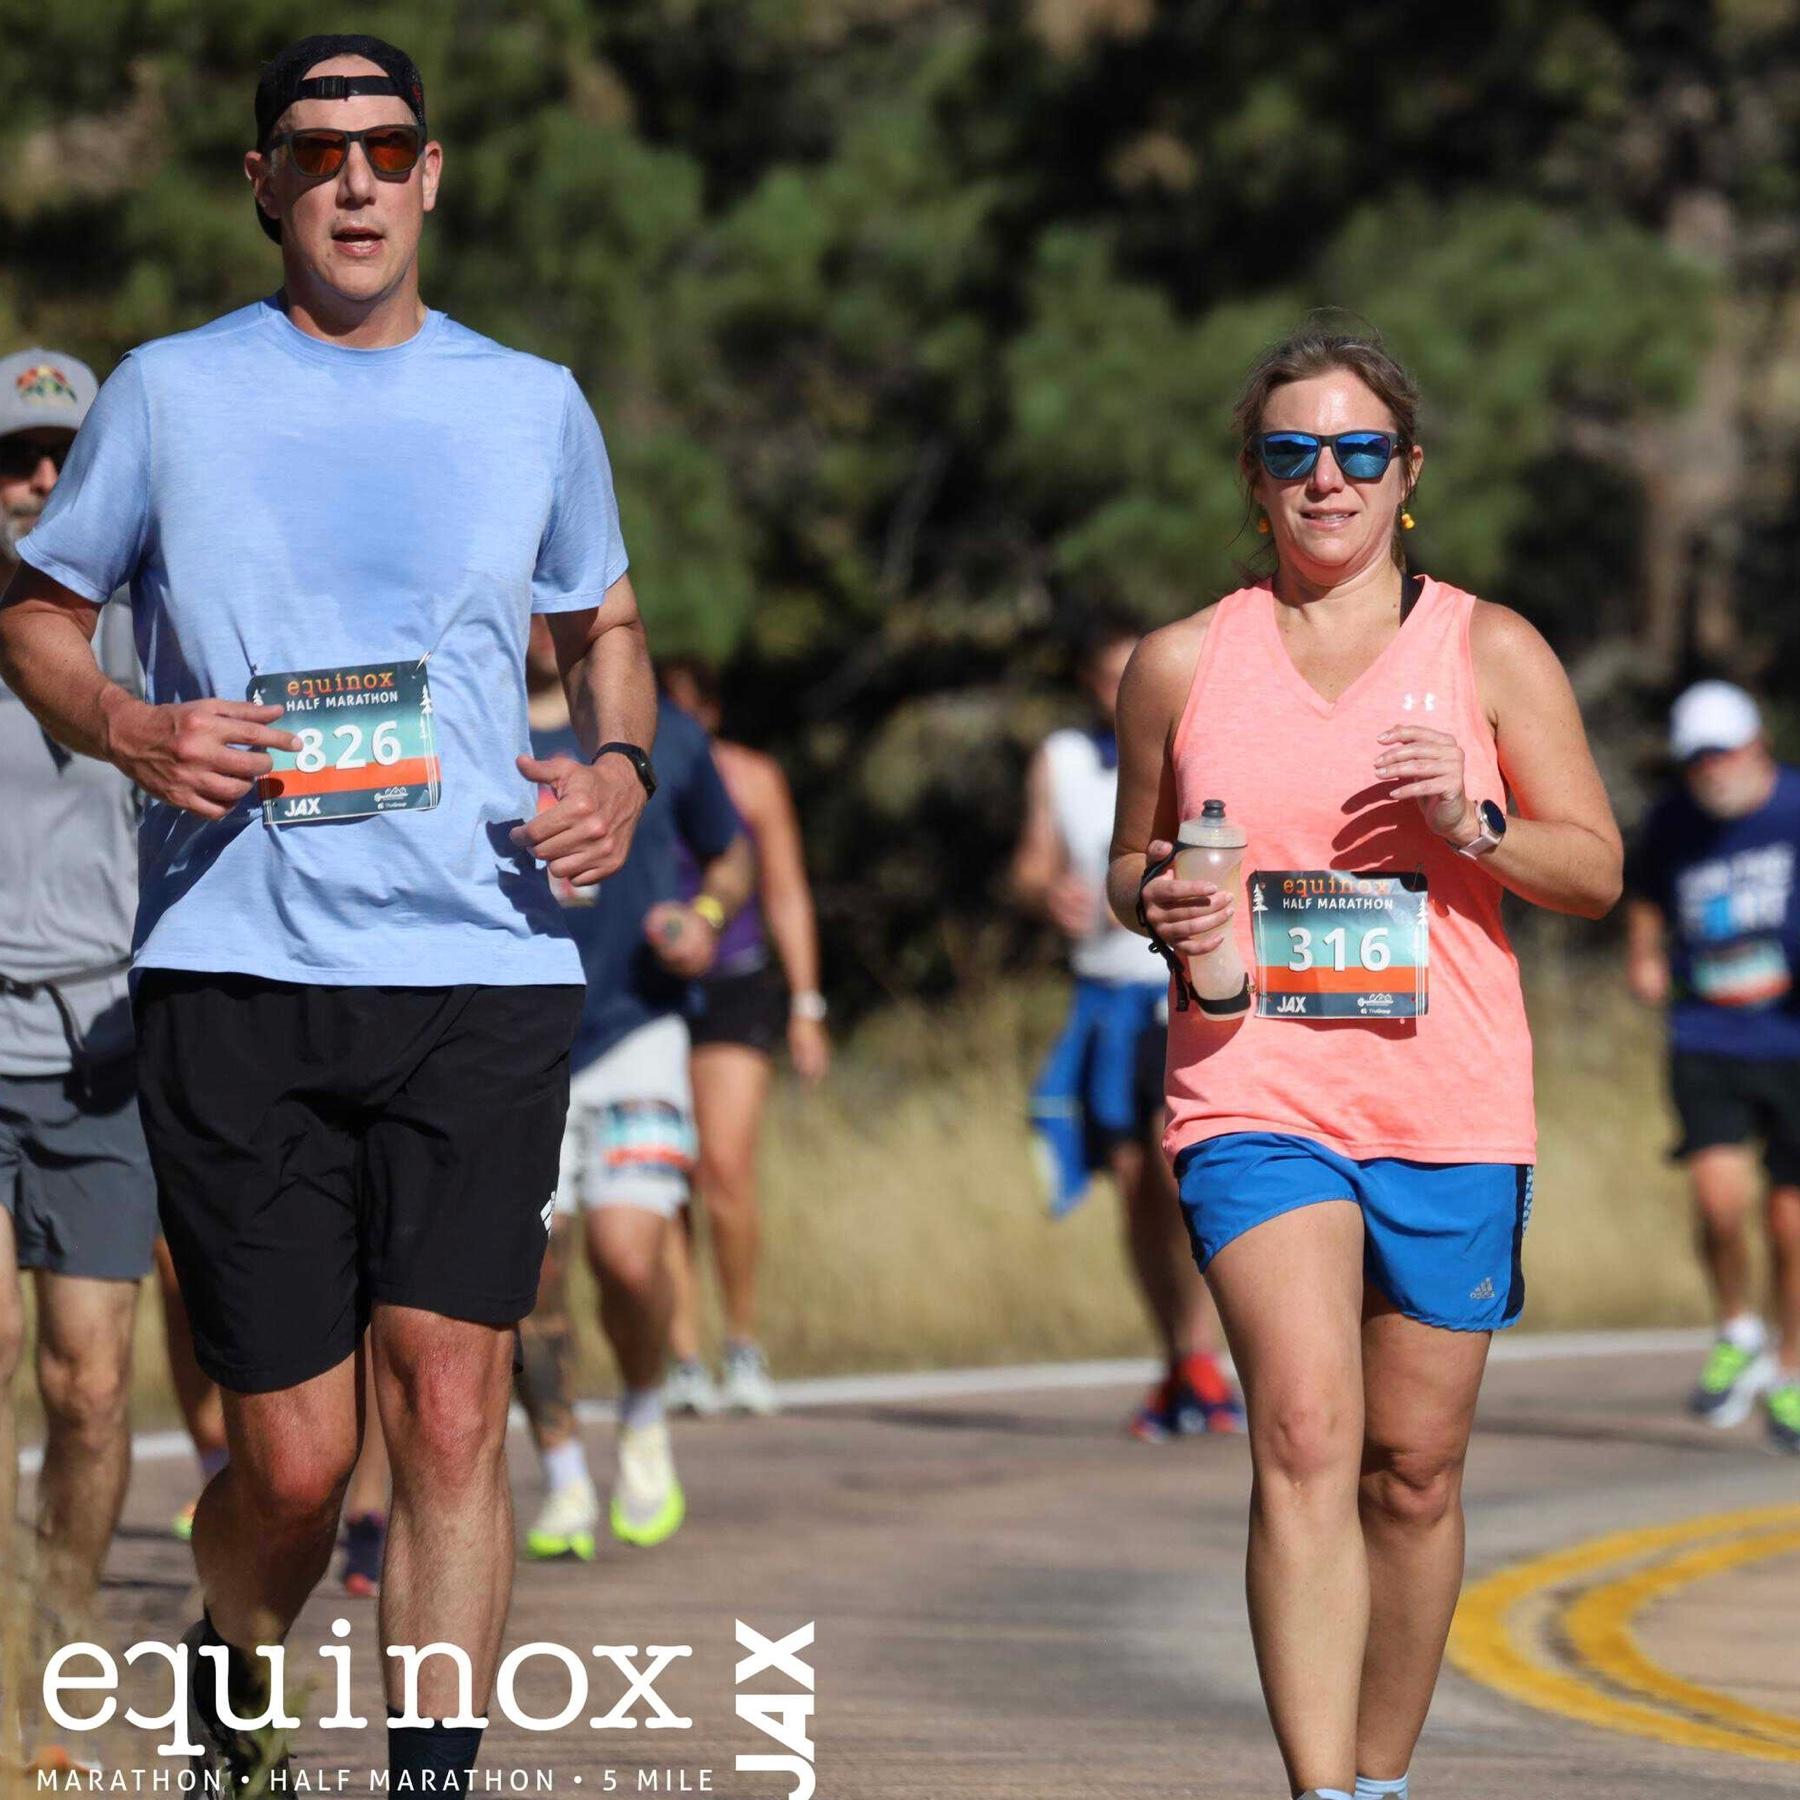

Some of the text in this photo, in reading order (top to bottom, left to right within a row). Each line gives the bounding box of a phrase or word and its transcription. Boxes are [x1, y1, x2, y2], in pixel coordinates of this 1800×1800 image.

[287, 671, 395, 698] equinox
[286, 691, 399, 712] HALF MARATHON
[296, 720, 402, 773] 826
[284, 797, 321, 817] JAX
[1283, 876, 1391, 898] equinox
[1283, 898, 1393, 910] HALF MARATHON
[1288, 927, 1391, 972] 316
[1276, 996, 1306, 1013] JAX
